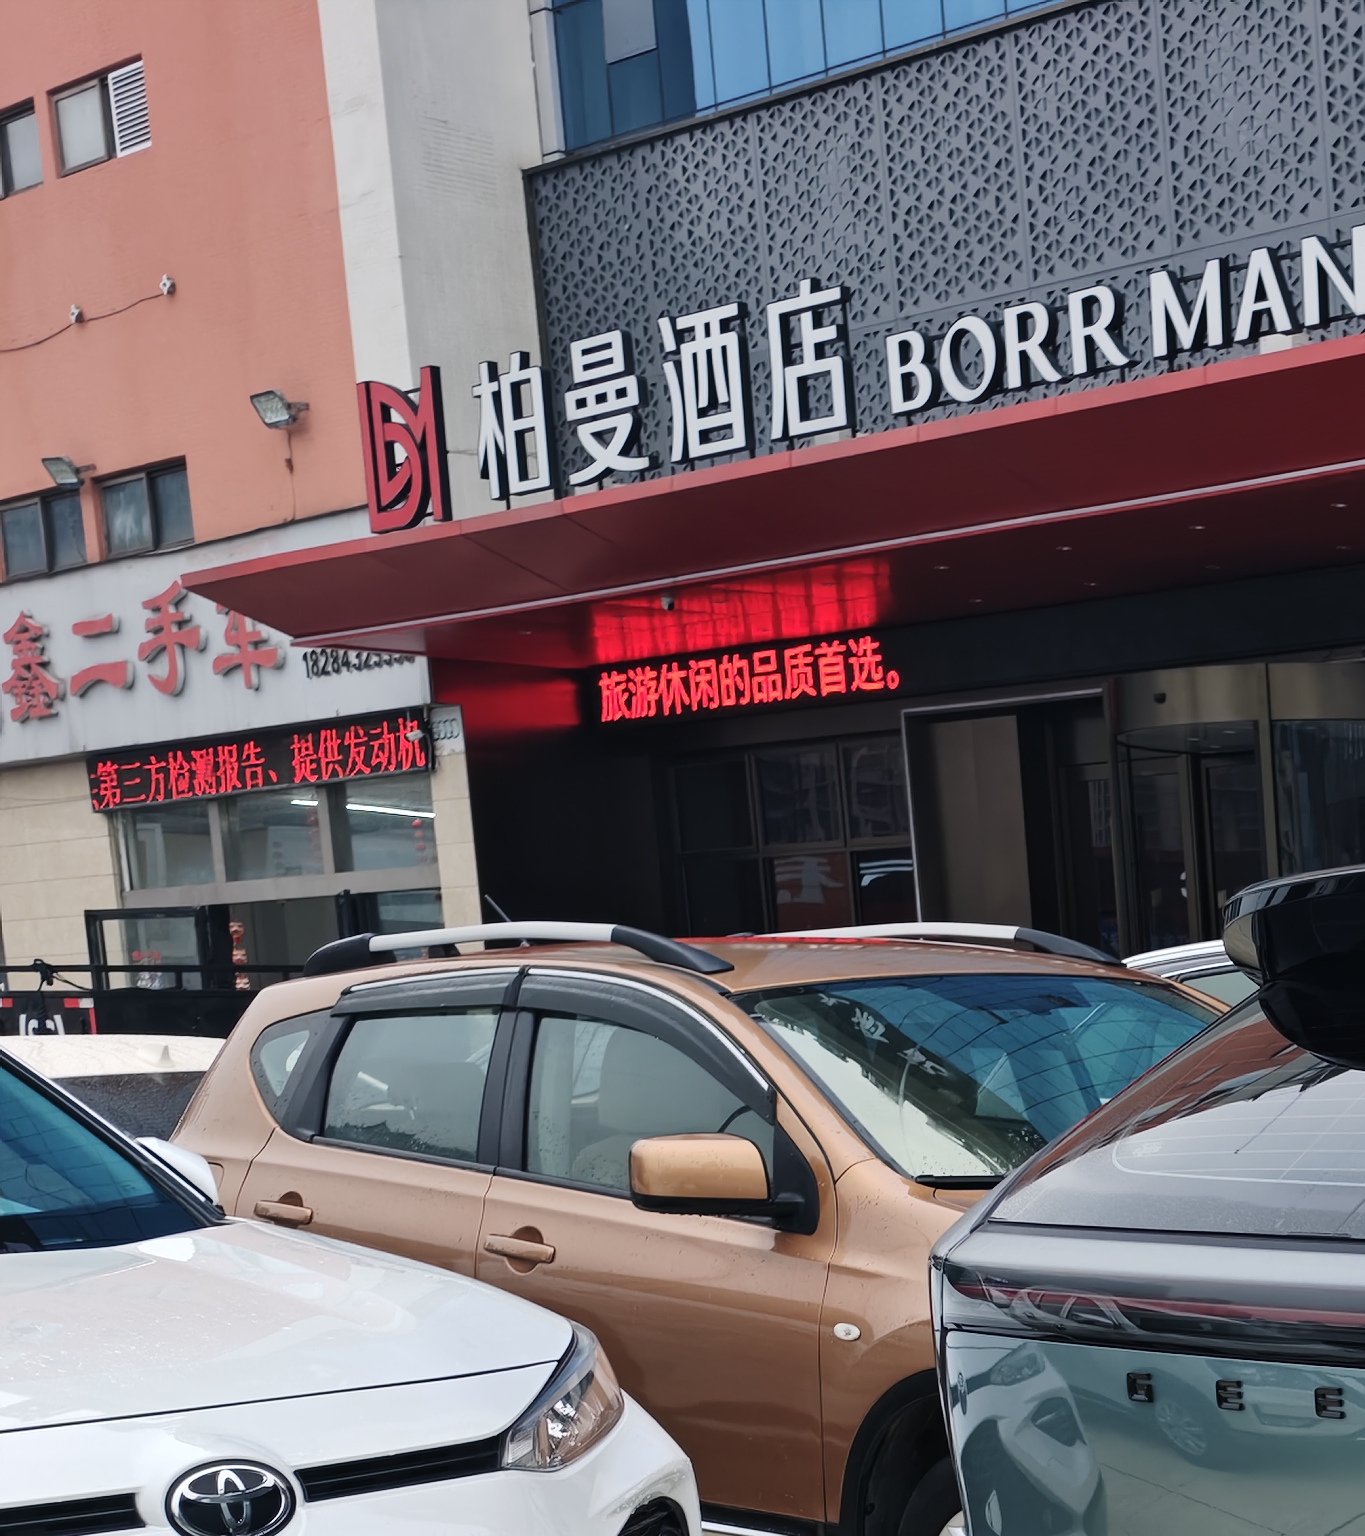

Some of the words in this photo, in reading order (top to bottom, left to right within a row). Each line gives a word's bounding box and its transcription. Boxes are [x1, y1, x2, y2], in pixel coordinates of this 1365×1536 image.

[472, 275, 851, 501] 柏曼酒店
[91, 718, 427, 810] 第三方检测报告、提供发动机
